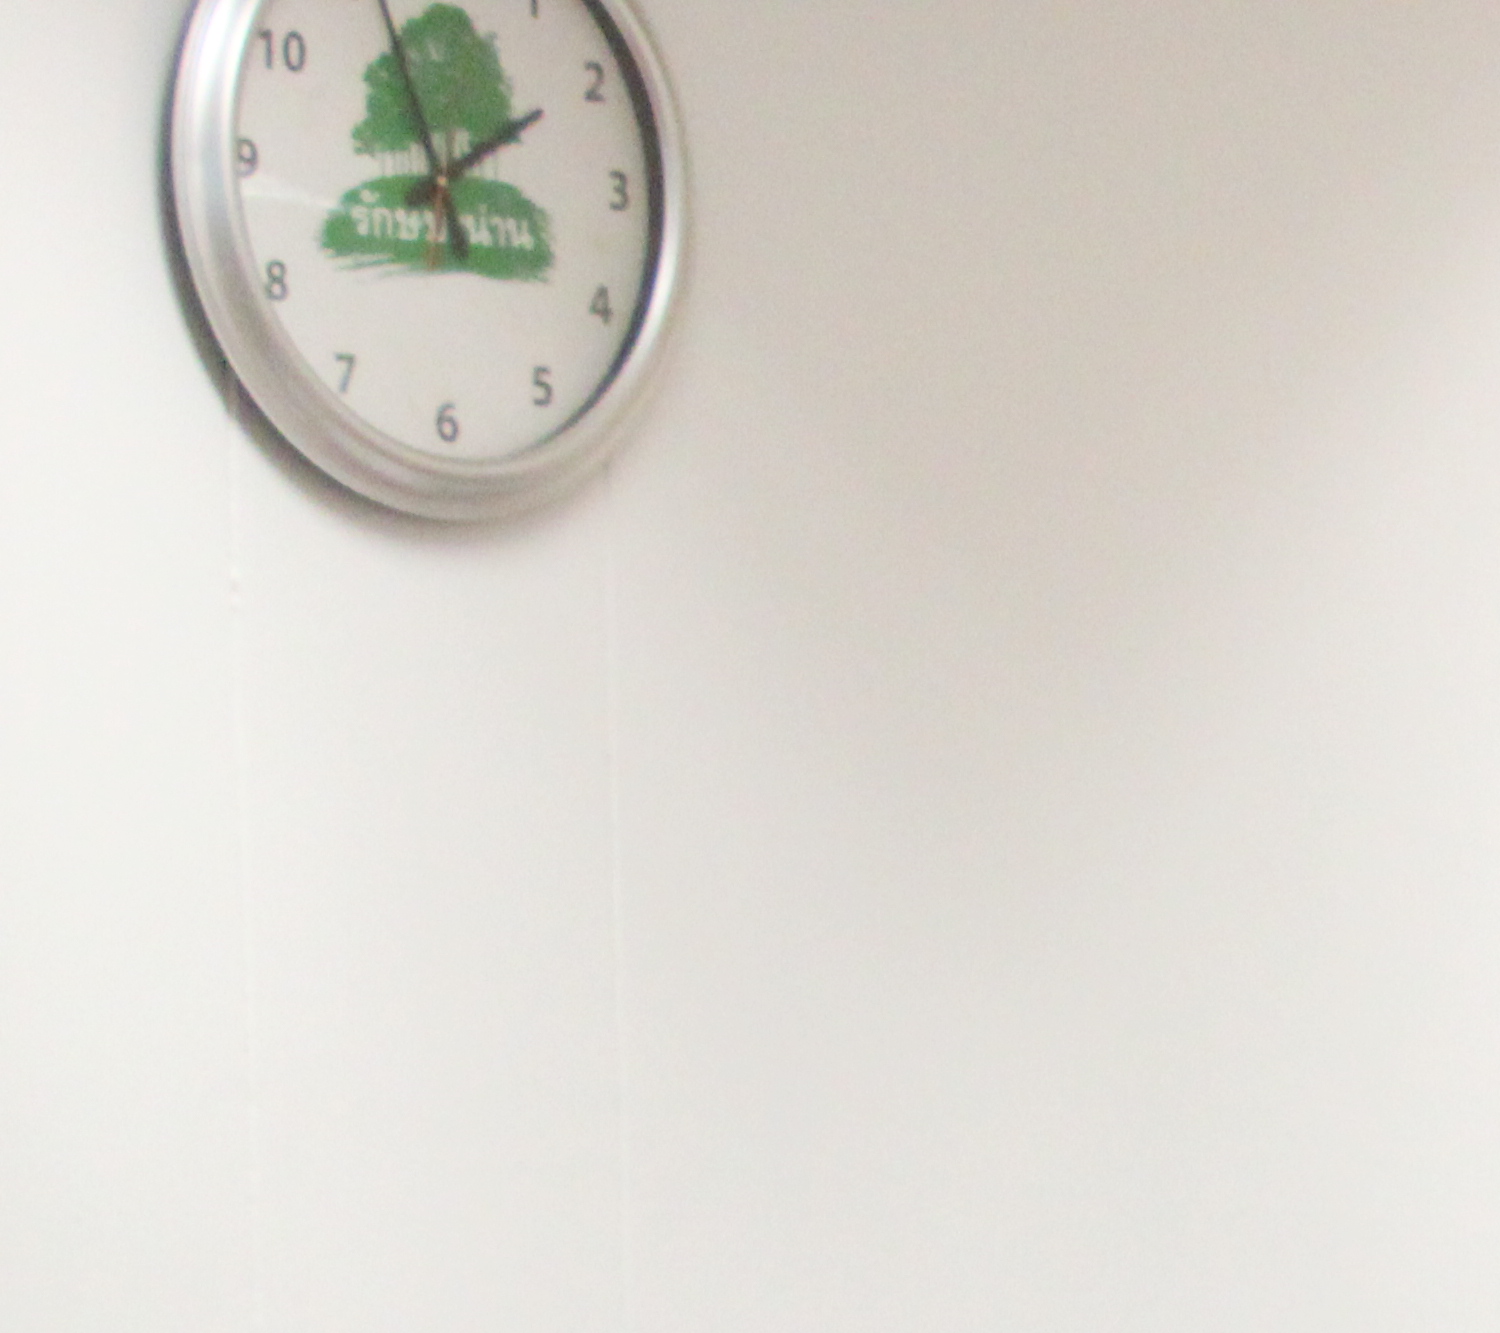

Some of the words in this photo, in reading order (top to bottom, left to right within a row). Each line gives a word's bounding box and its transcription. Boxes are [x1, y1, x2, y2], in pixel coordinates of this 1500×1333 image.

[258, 30, 306, 72] 10
[583, 61, 606, 104] 2
[237, 138, 259, 177] 9
[608, 171, 631, 211] 3
[351, 188, 535, 250] รักษปน่าน
[264, 260, 288, 300] 8
[588, 284, 612, 324] 4
[335, 353, 355, 394] 7
[531, 366, 553, 406] 5
[436, 403, 459, 442] 6
